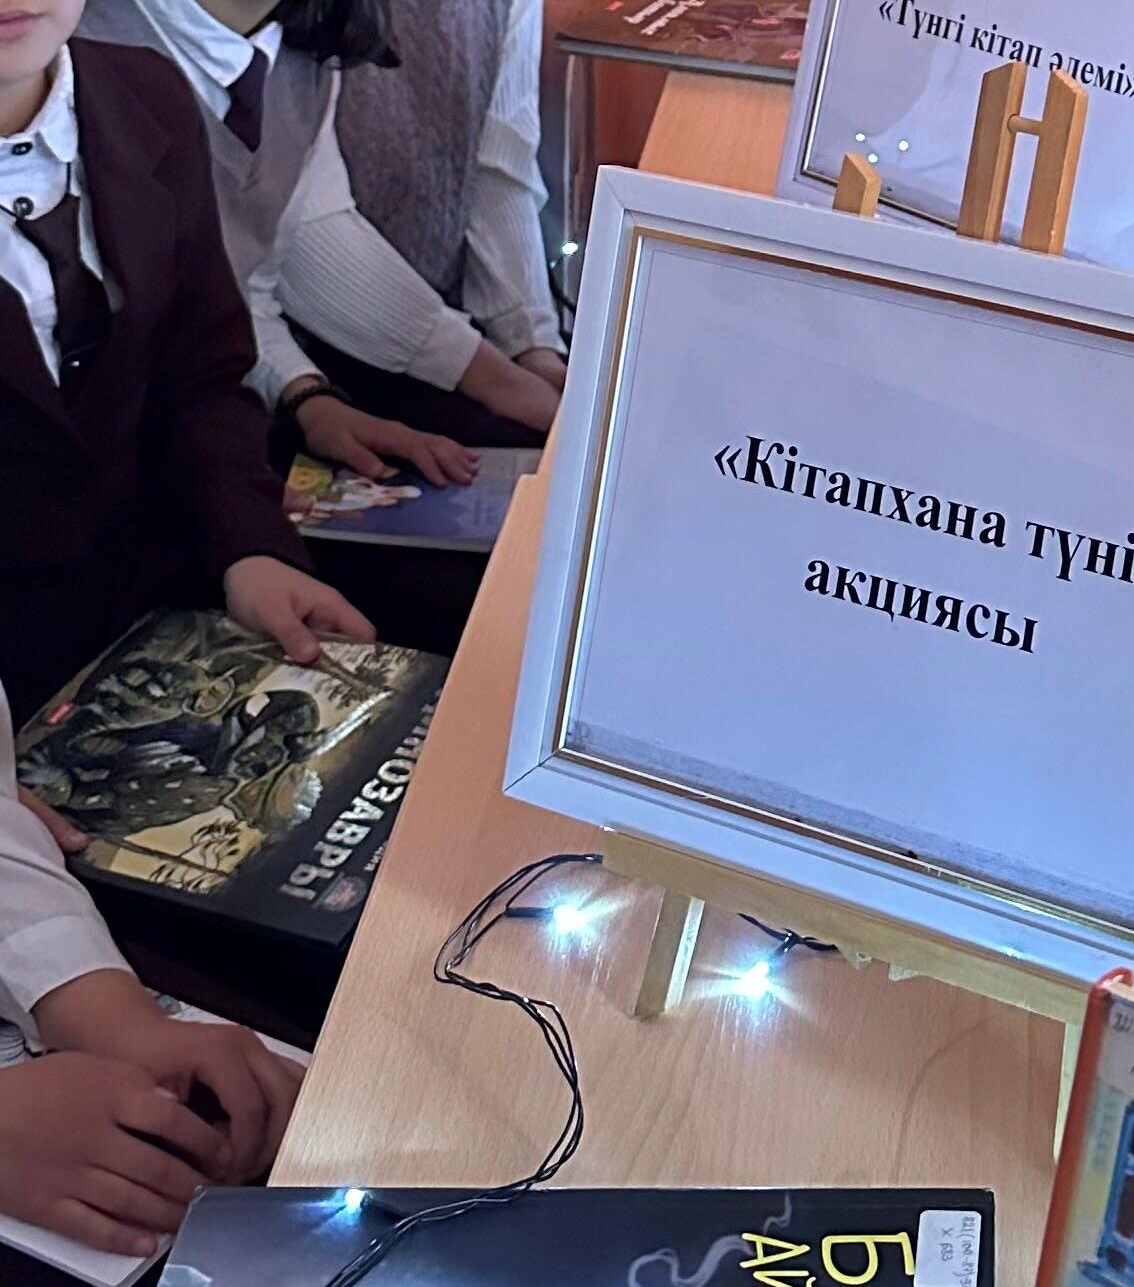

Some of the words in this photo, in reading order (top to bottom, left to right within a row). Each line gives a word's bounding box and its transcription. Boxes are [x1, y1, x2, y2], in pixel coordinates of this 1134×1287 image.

[969, 23, 1043, 68] кітап
[714, 435, 1006, 549] «Кітапхана
[803, 559, 1039, 654] акциясы
